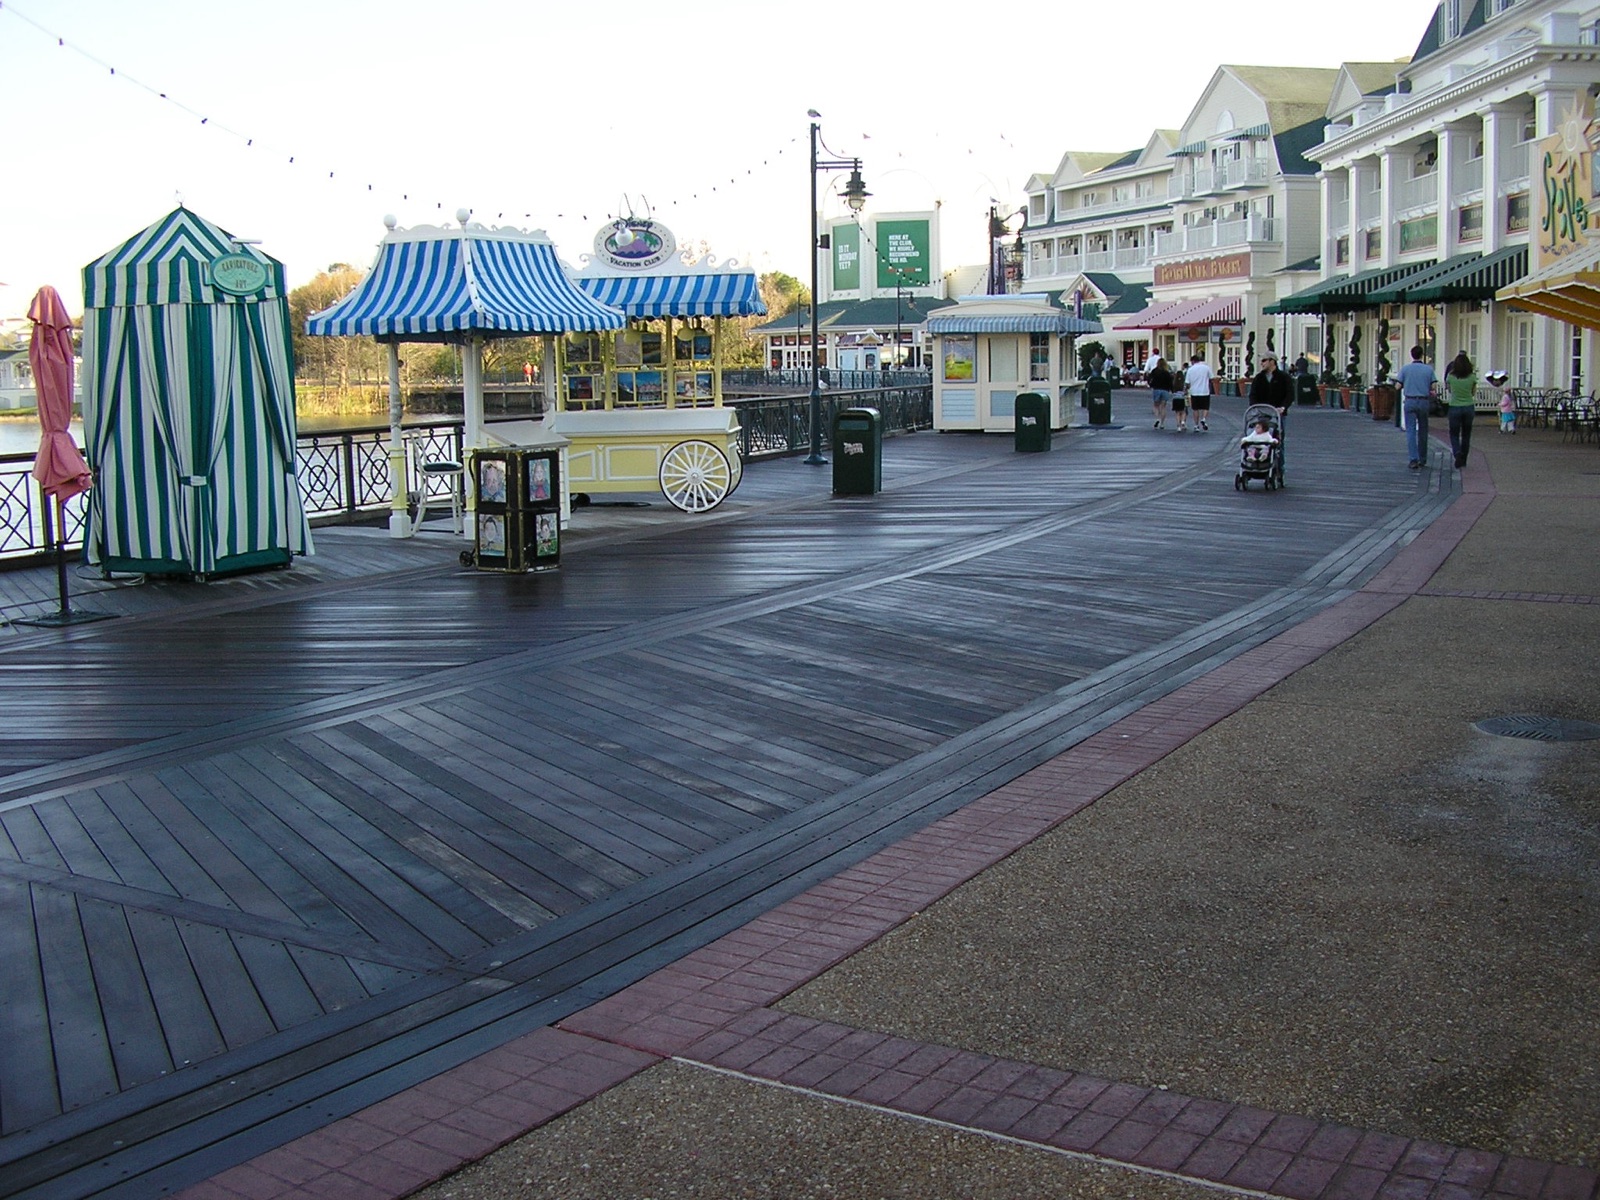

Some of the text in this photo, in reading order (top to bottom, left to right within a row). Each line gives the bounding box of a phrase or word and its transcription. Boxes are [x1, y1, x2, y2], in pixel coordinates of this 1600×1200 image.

[844, 244, 850, 253] IT
[838, 252, 858, 261] MONDAY
[838, 261, 851, 270] YET?
